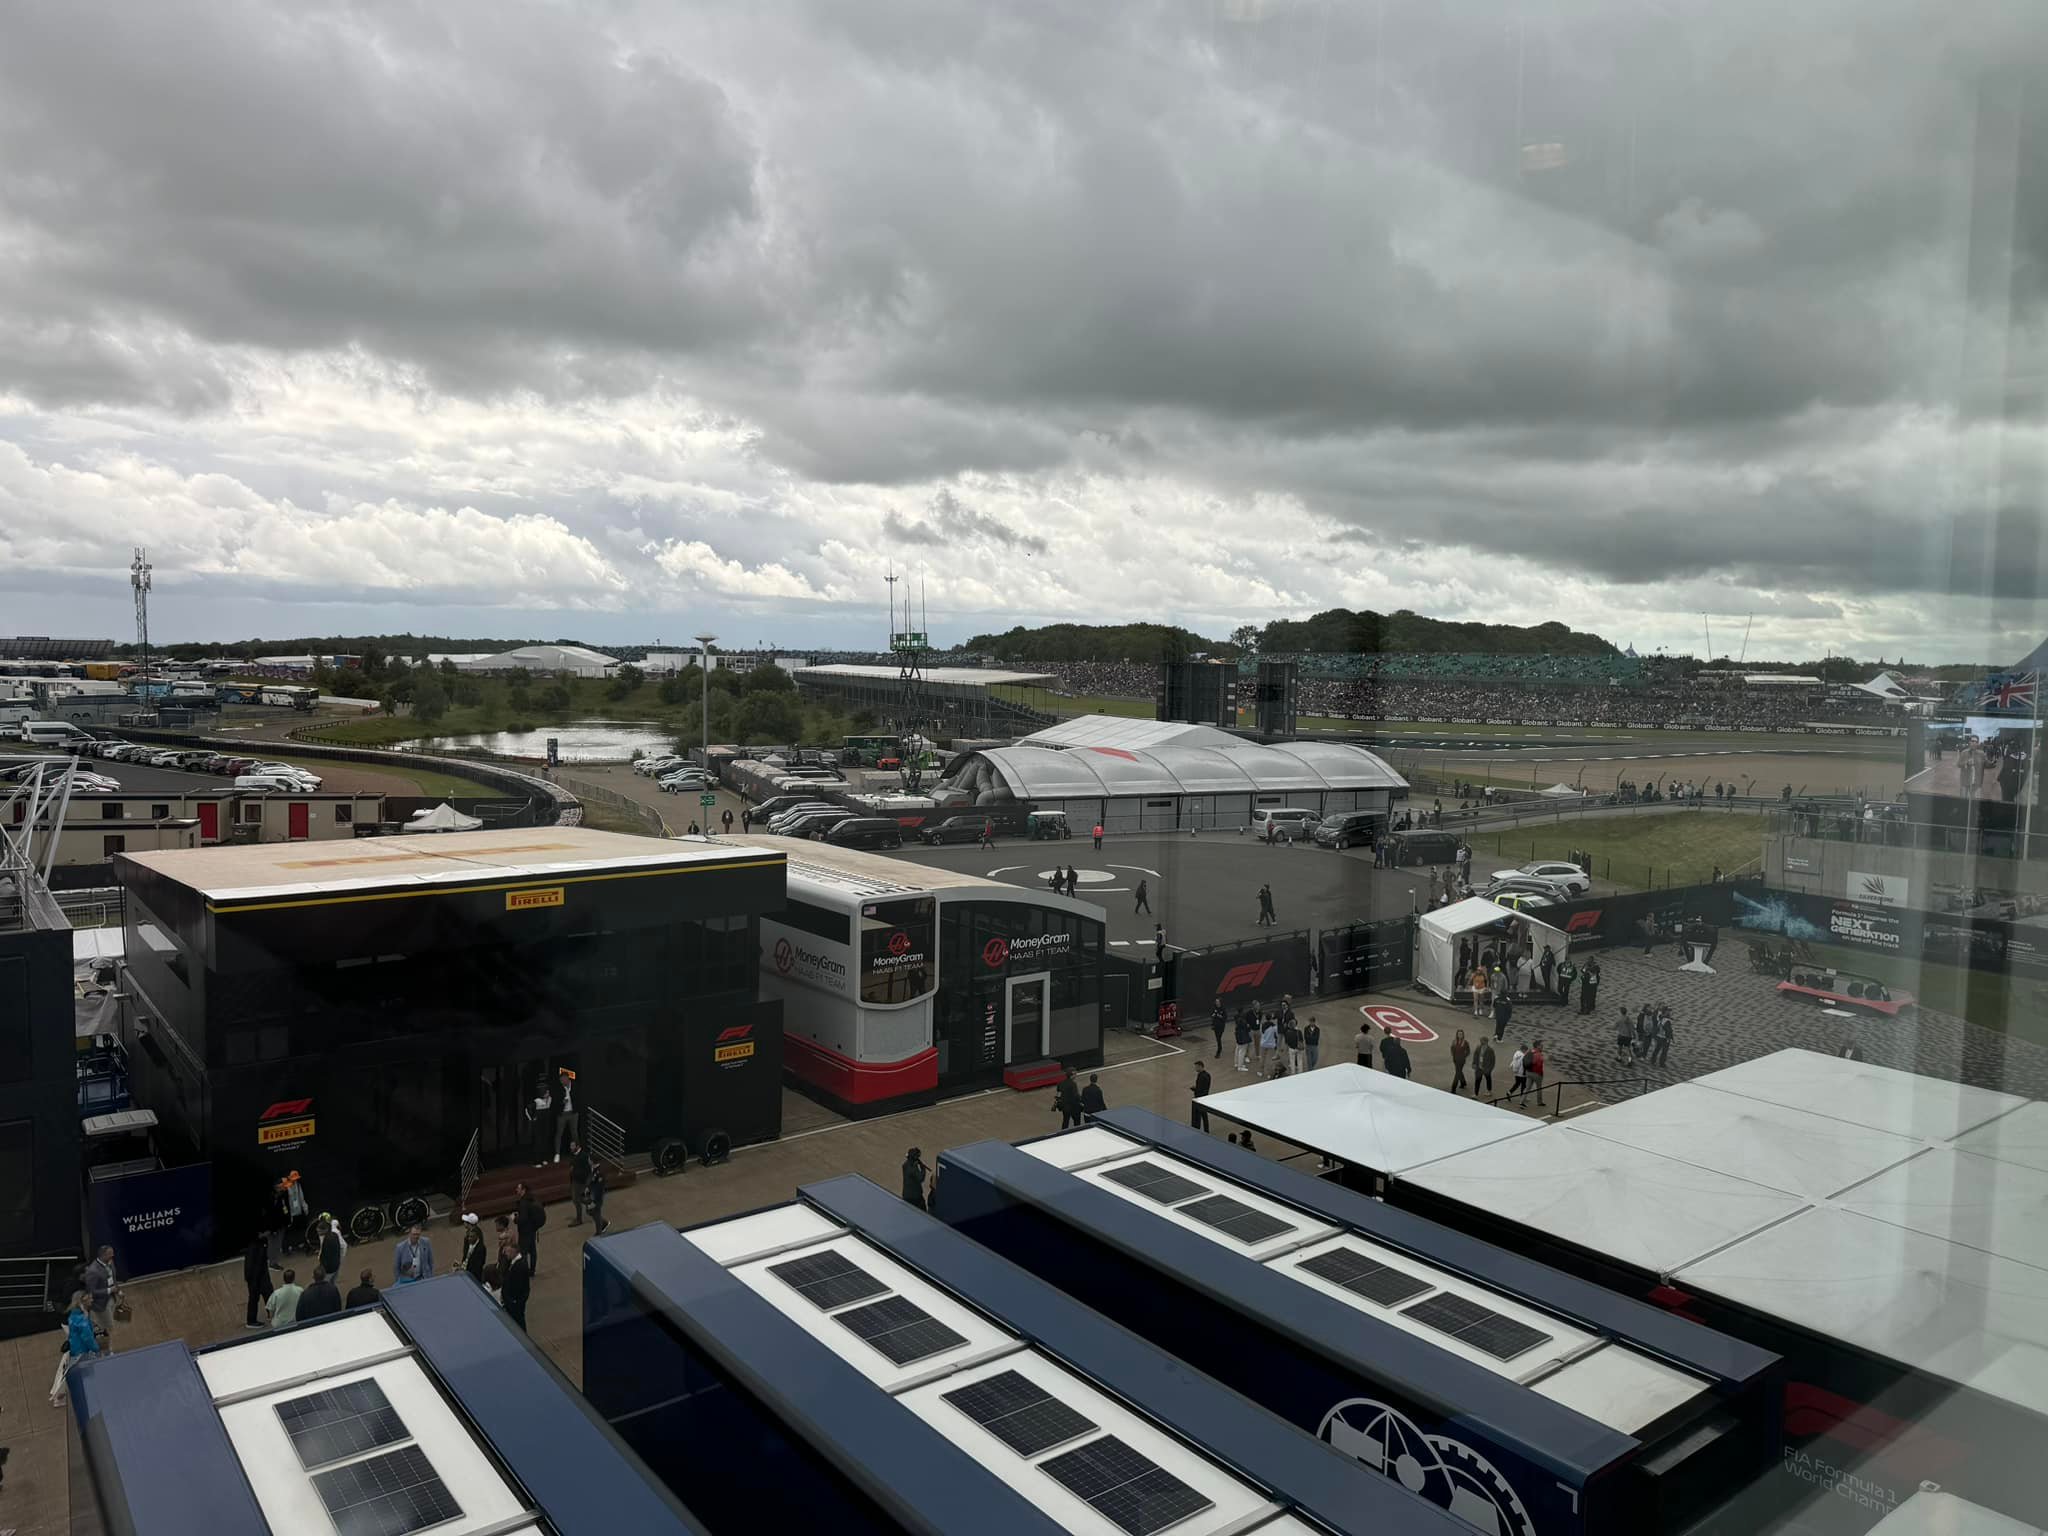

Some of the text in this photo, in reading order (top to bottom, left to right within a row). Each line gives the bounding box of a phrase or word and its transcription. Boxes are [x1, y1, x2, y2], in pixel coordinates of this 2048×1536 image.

[1855, 728, 1884, 736] Globant
[511, 890, 560, 906] PIRELLI
[1831, 909, 1857, 918] Formula
[1831, 915, 1875, 930] NEXT
[1010, 933, 1070, 950] MoneyGram
[794, 946, 846, 977] MoneyGram
[873, 951, 924, 967] MoneyGram
[1010, 946, 1070, 960] HAAS F1 TEAM
[263, 1122, 311, 1141] PIRELLI
[122, 1207, 181, 1225] WILLIAMS
[128, 1216, 175, 1233] RACING
[1783, 1445, 1898, 1505] FIA Formula 1
[1784, 1458, 1833, 1492] World
